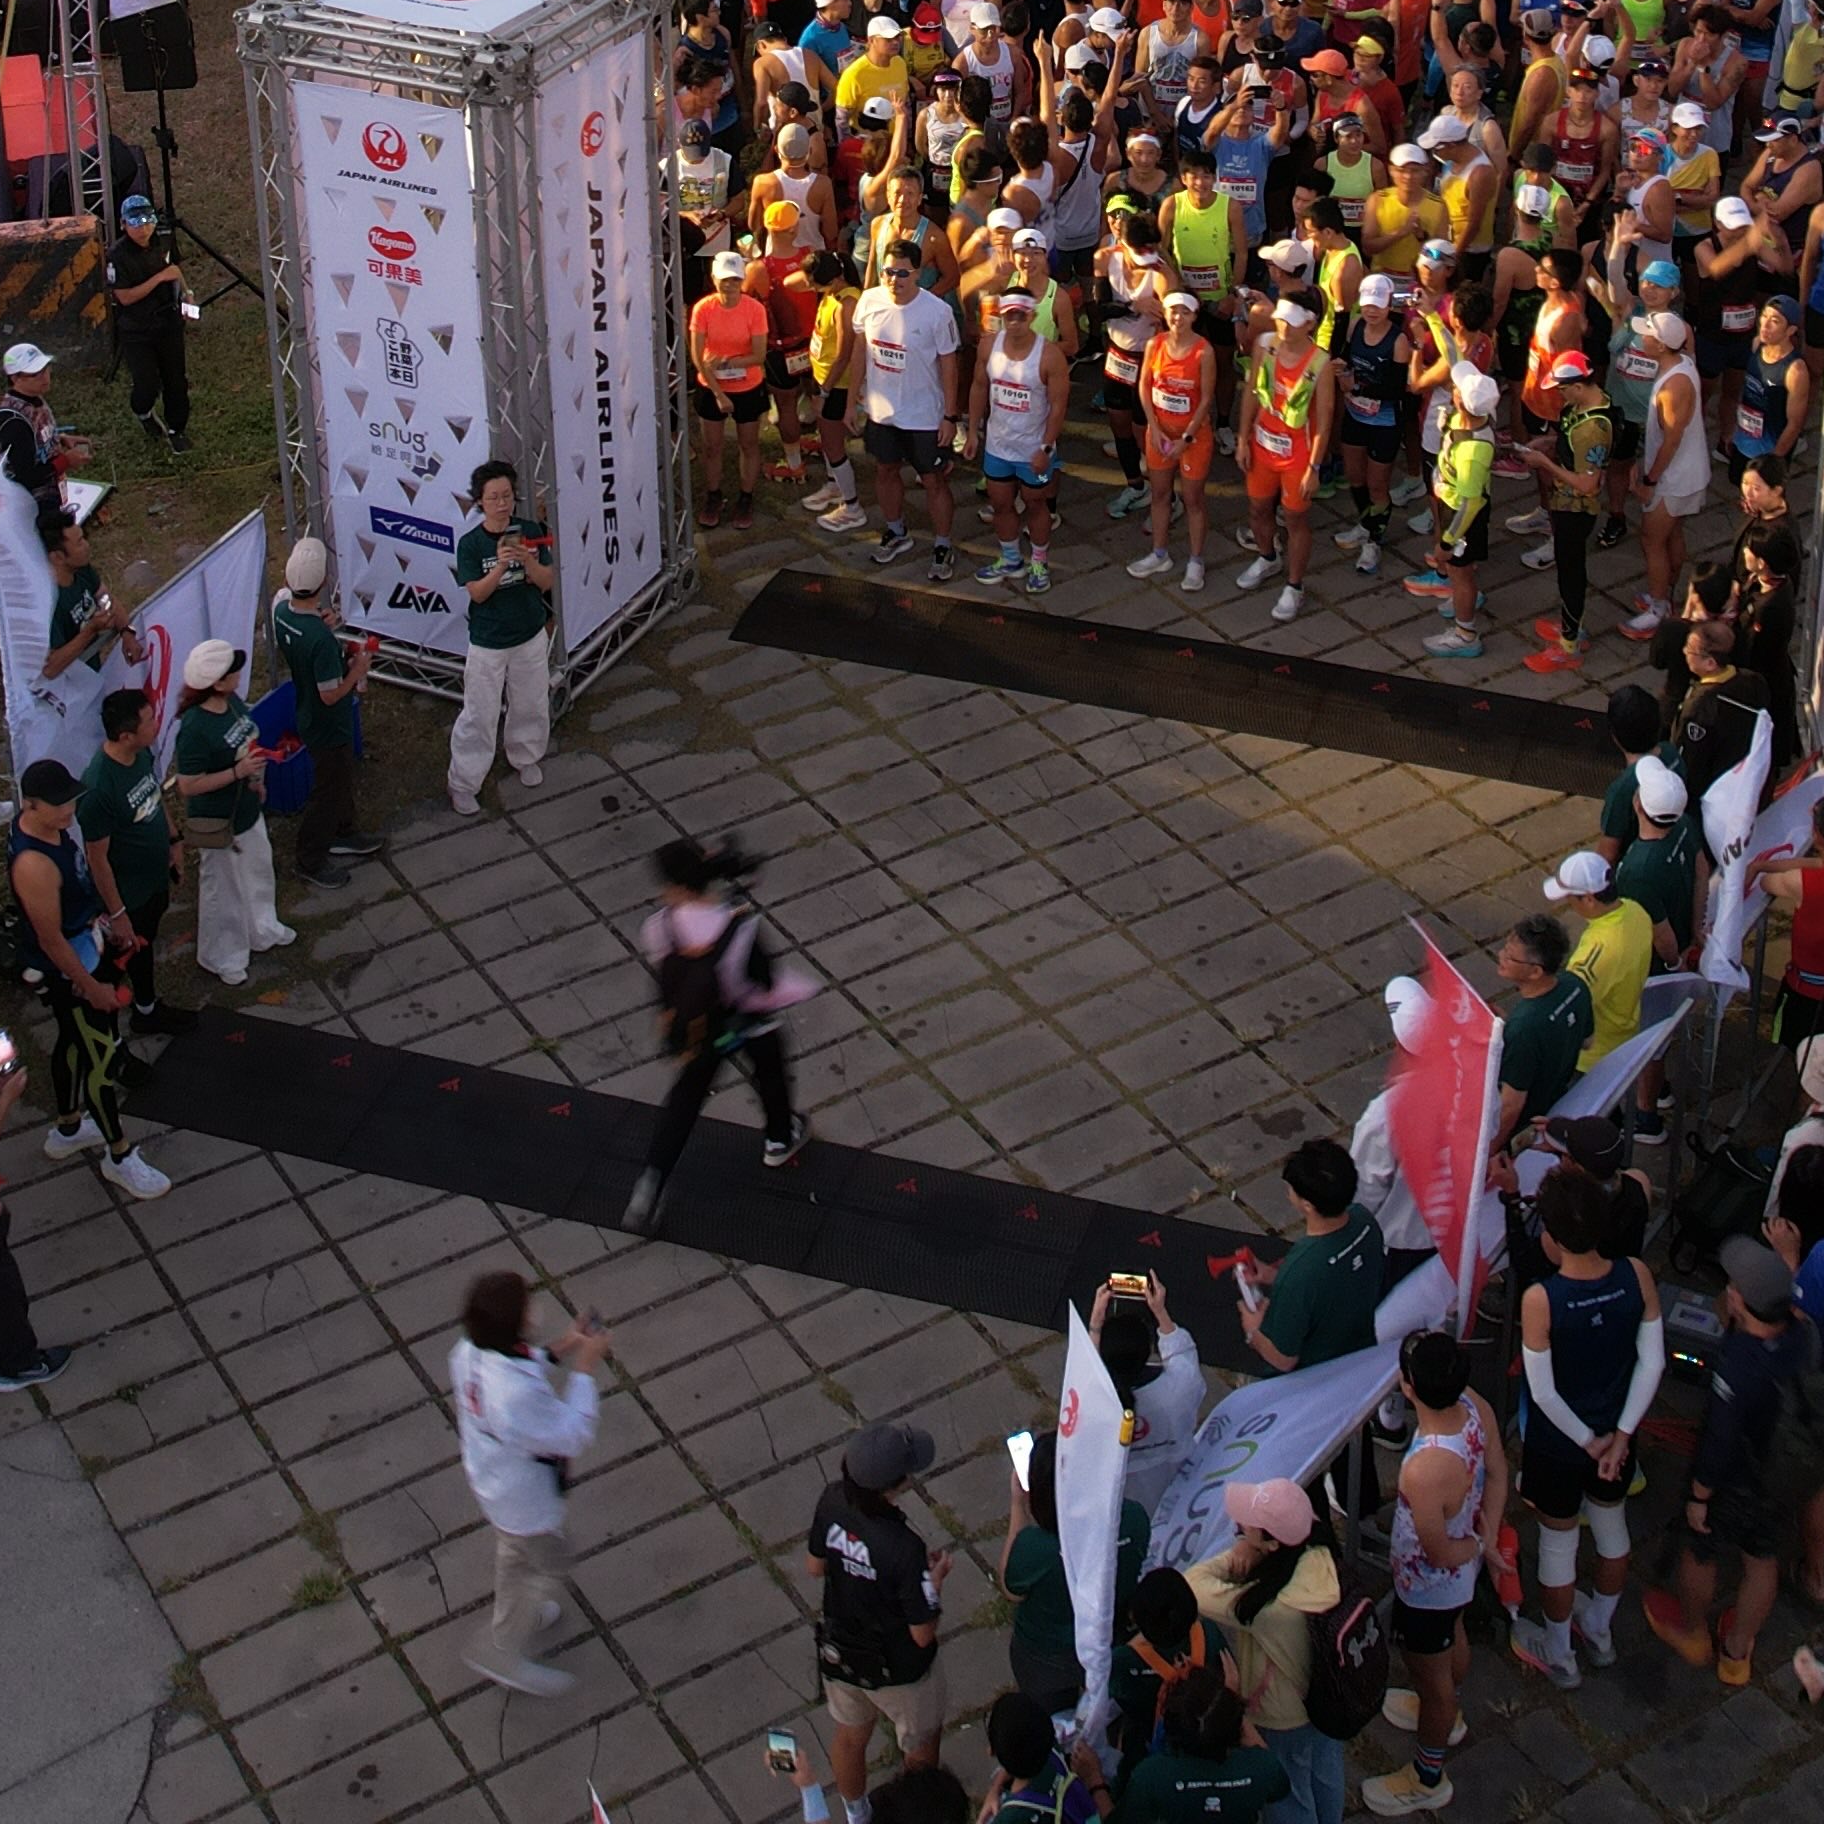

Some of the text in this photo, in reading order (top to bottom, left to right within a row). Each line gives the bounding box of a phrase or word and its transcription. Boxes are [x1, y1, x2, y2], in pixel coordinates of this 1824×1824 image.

[375, 156, 400, 168] JAL
[337, 169, 438, 195] JAPAN AIRLINES
[370, 231, 416, 253] Kagome
[366, 259, 423, 286] 可果美
[587, 180, 619, 566] JAPAN AIRLINES
[369, 421, 426, 453] snug
[387, 582, 451, 614] LAVA
[826, 1522, 870, 1566] LAVA
